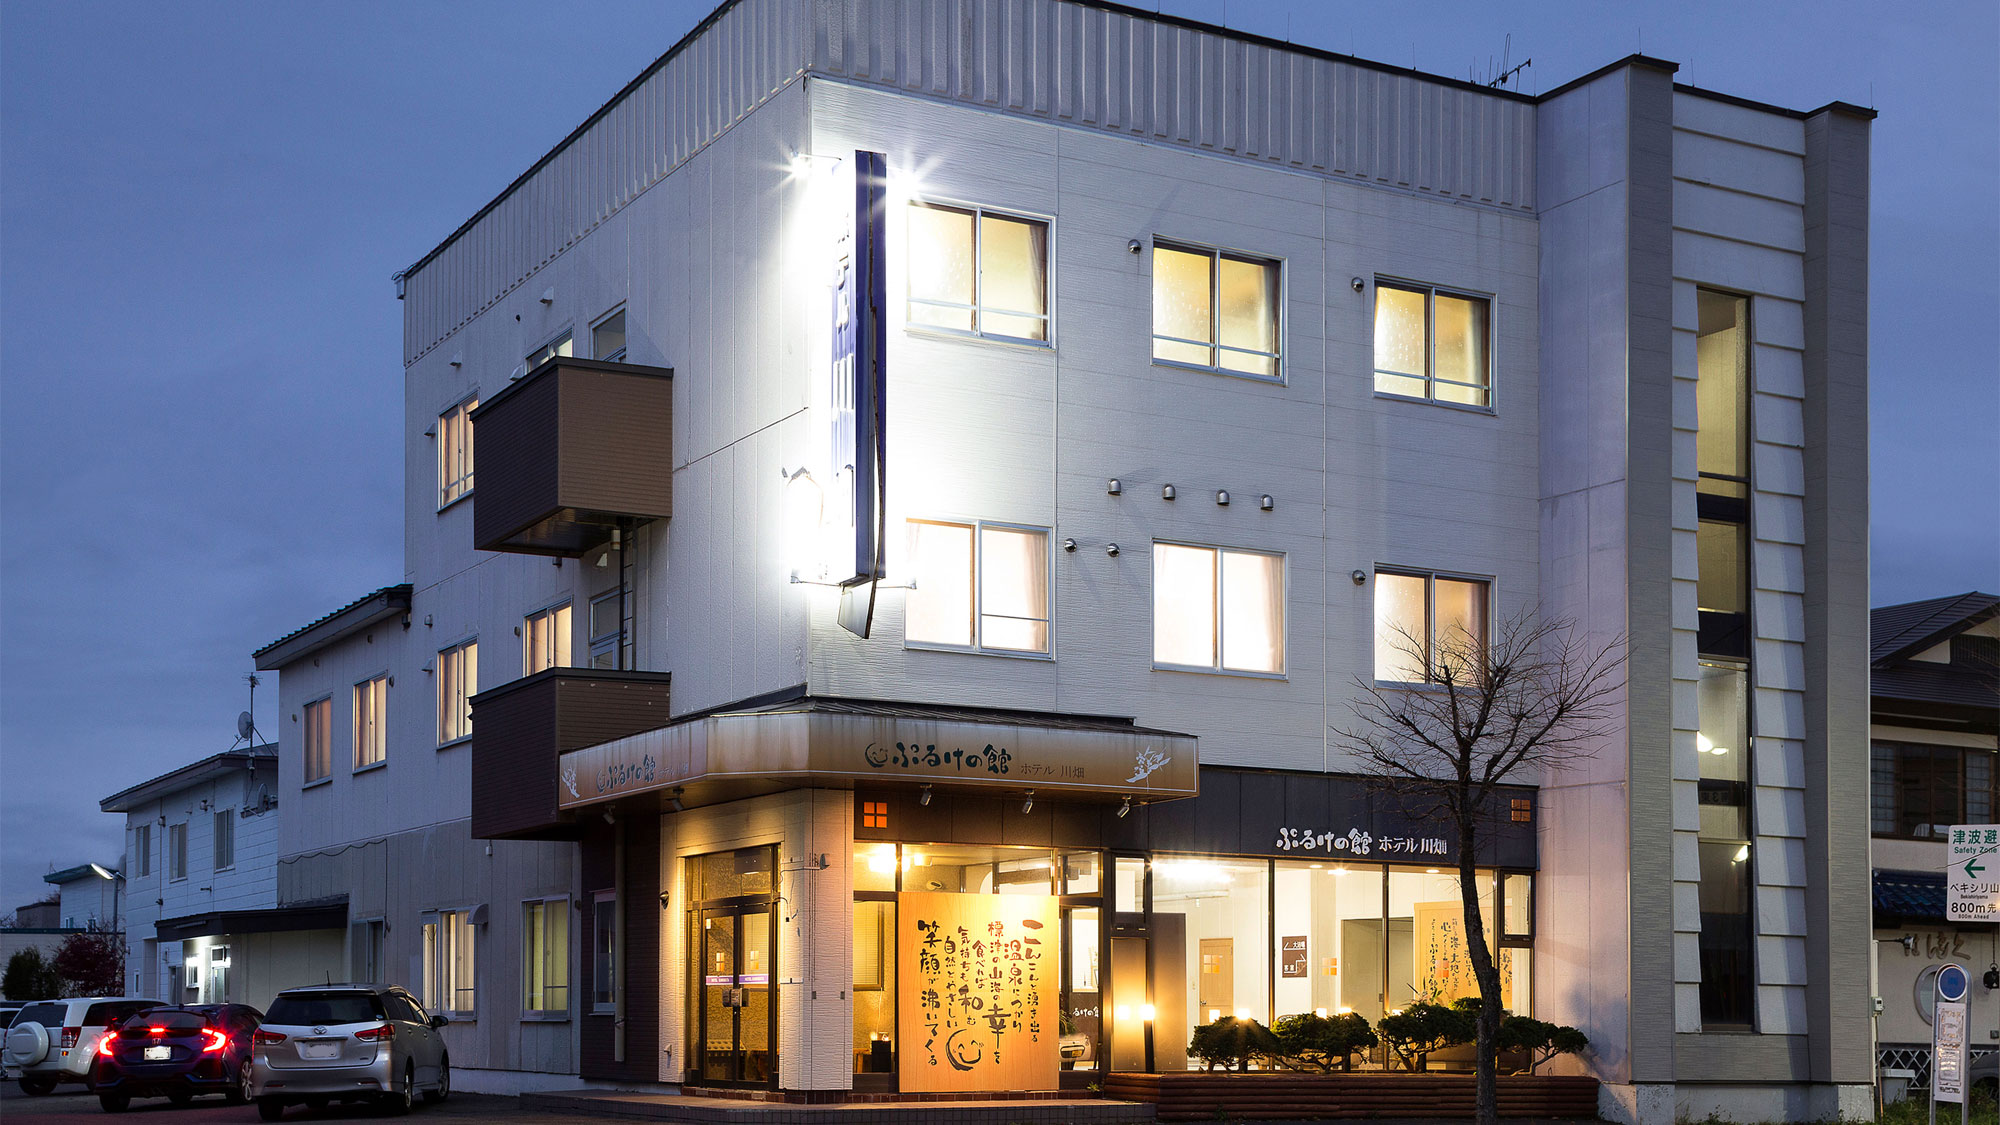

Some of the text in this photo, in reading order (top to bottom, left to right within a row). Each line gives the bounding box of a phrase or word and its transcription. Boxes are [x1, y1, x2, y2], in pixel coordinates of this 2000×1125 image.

[606, 754, 656, 789] ぷるけの館
[893, 741, 1085, 779] ぷるけの館 ホテル 川畑
[1276, 827, 1373, 855] ぷるけの館
[1952, 829, 1998, 845] 津波避
[1954, 846, 1998, 855] Safety Zone
[1950, 883, 1999, 894] ベキシリ山
[944, 936, 958, 1028] 自然とやさしい
[958, 925, 984, 1026] 気持ちも和む
[972, 940, 988, 989] 食べれば
[917, 919, 942, 1066] 笑顔が沸いてくる
[1003, 939, 1025, 1033] 温泉につかり
